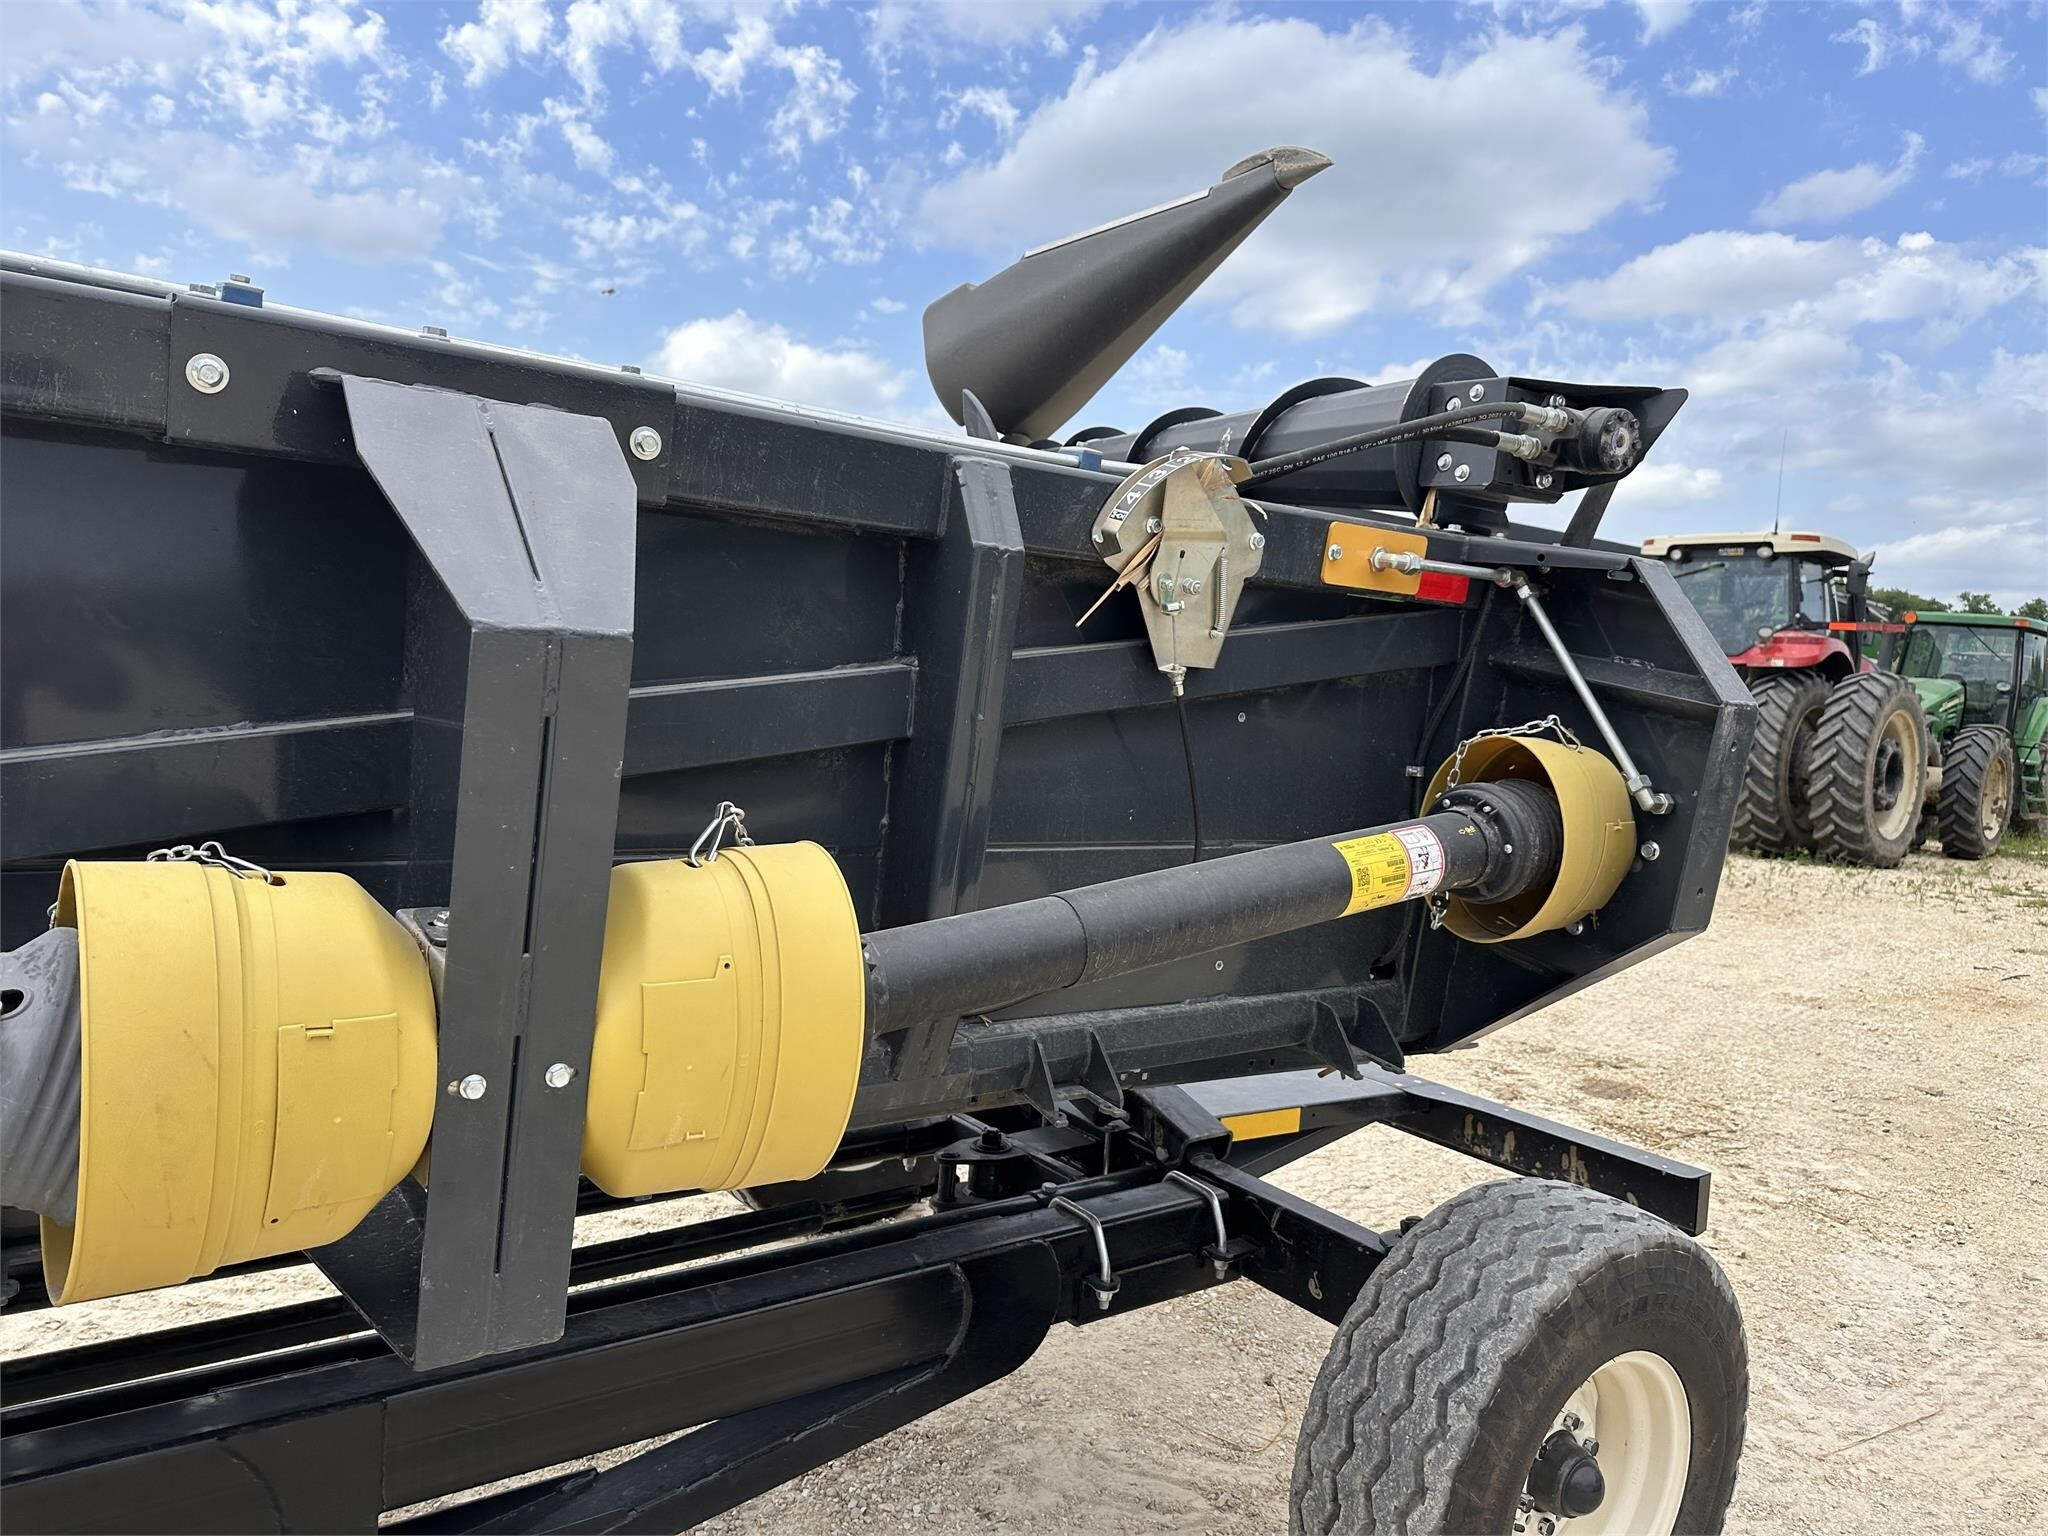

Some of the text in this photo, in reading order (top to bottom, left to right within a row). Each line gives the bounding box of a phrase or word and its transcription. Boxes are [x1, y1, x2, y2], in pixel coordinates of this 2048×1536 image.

[1312, 454, 1325, 463] SAE
[1326, 451, 1338, 459] 100
[1126, 491, 1141, 504] 4
[1148, 469, 1167, 480] 3
